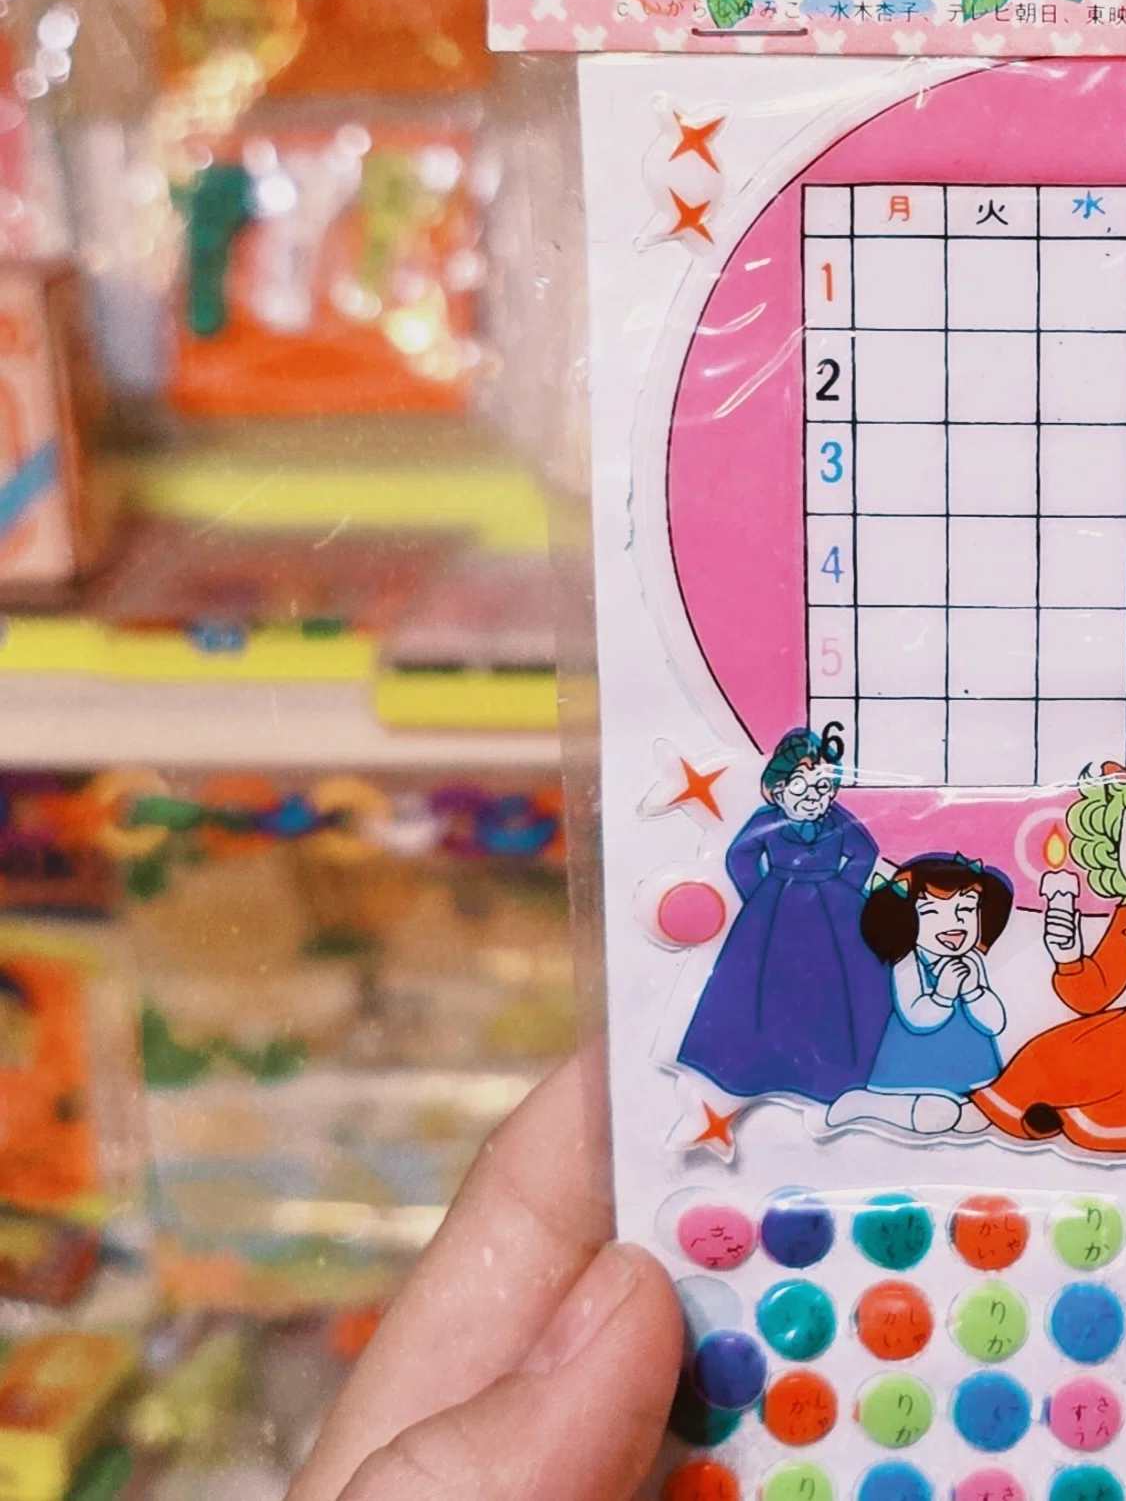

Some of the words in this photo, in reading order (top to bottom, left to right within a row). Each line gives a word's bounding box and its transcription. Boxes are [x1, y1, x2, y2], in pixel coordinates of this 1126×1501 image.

[888, 195, 911, 221] 月
[976, 199, 1008, 225] 火
[1072, 191, 1105, 219] 水
[821, 263, 833, 302] 1
[816, 358, 840, 401] 2
[820, 441, 843, 483] 3
[821, 546, 844, 583] 4
[820, 638, 843, 677] 5
[821, 721, 845, 763] 6
[1084, 1205, 1111, 1262] りか
[988, 1298, 1013, 1355] りか
